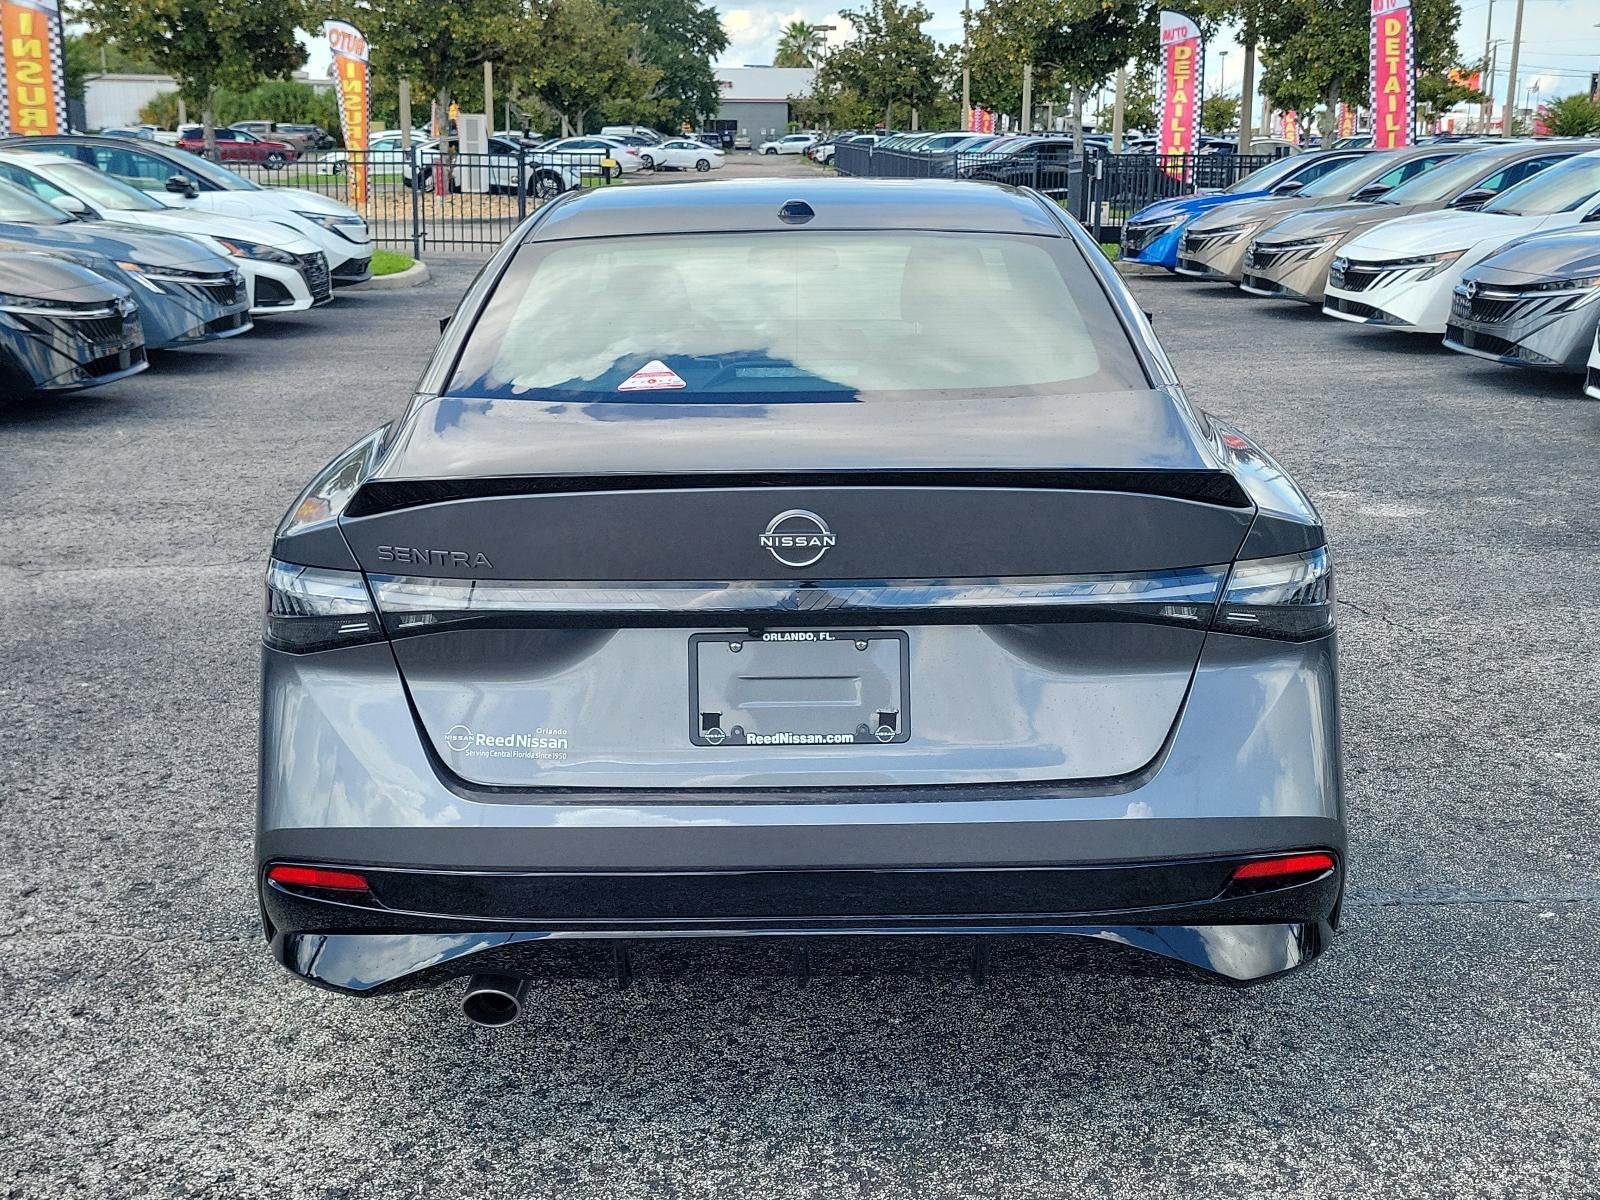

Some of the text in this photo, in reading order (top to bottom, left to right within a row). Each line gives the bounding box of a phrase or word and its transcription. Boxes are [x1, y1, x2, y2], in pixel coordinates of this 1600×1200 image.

[760, 536, 836, 547] NISSAN
[377, 545, 494, 569] SENTRA
[762, 632, 836, 642] ORLANDO, FL.
[536, 727, 567, 735] Orlando
[746, 732, 854, 745] ReedNissan.com
[465, 750, 490, 758] Serving
[490, 750, 513, 758] Central
[513, 750, 534, 759] Florida
[552, 752, 567, 760] 1950
